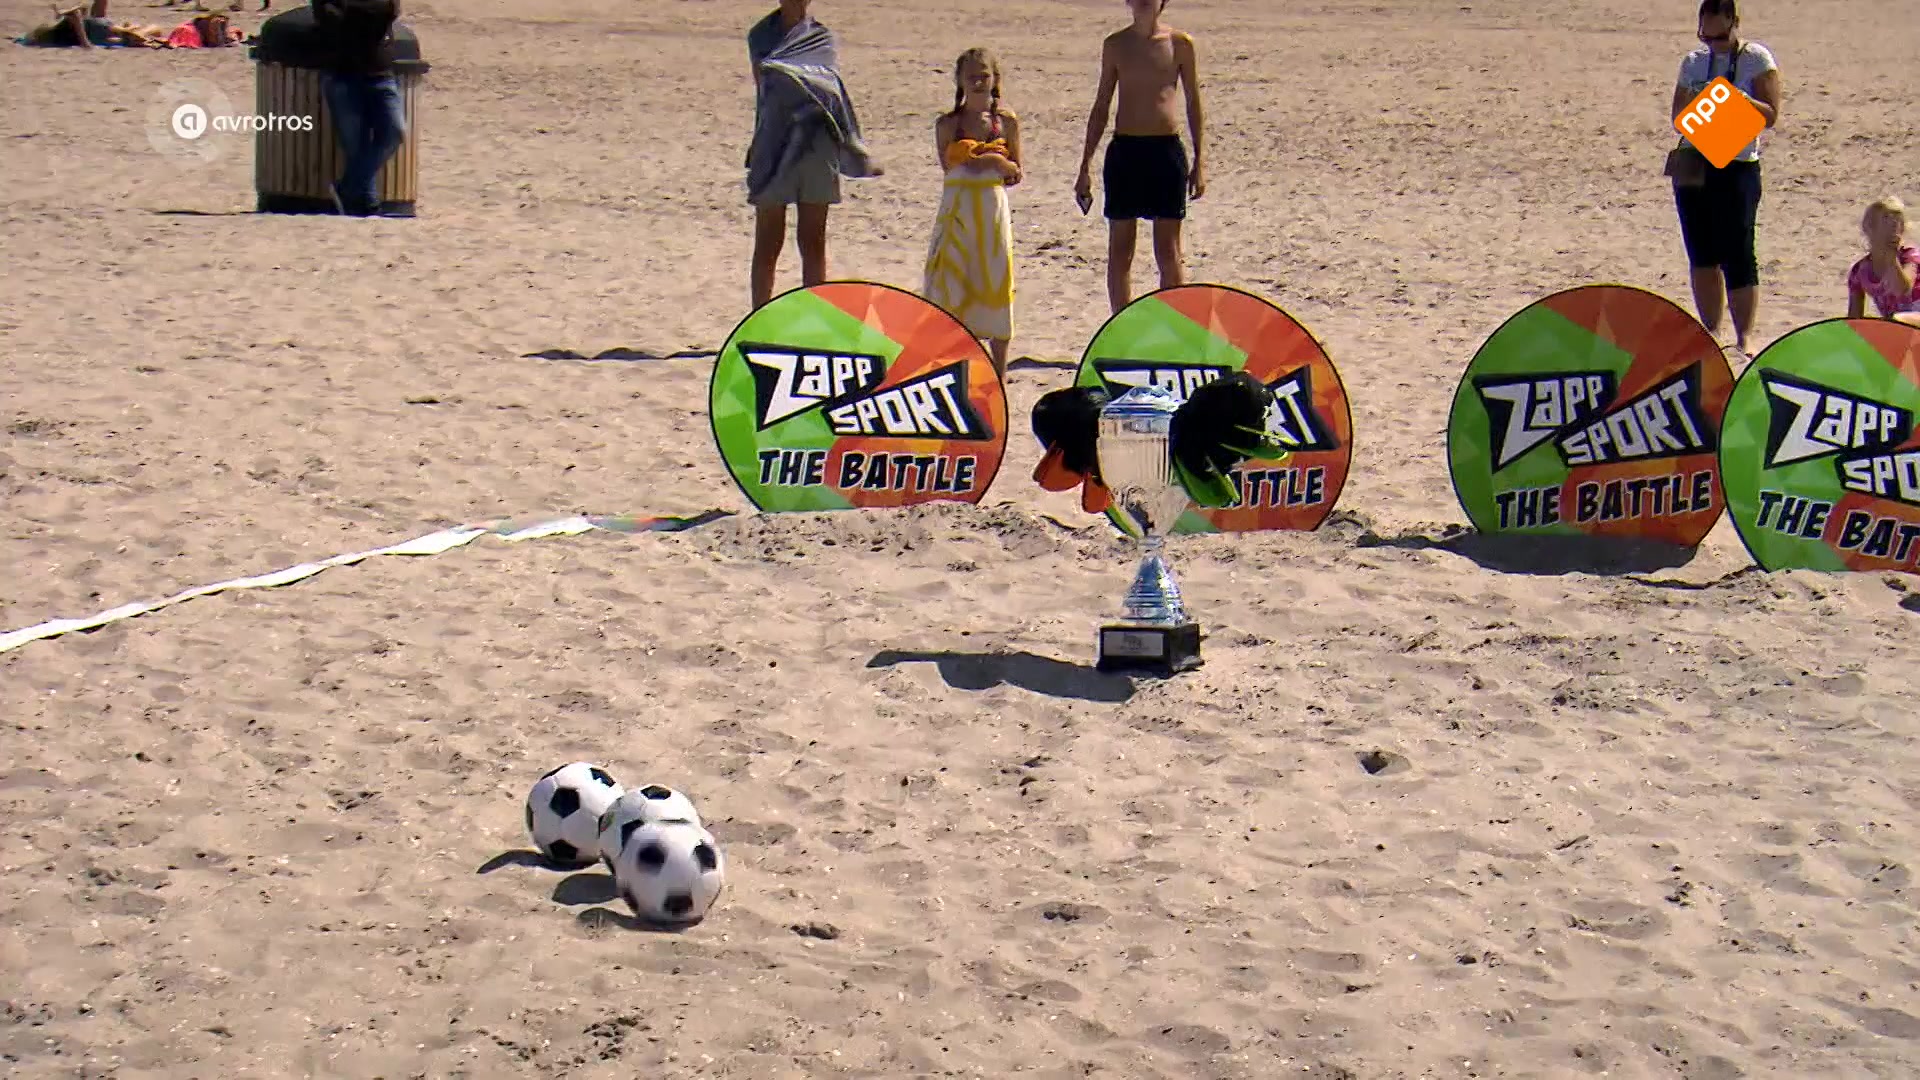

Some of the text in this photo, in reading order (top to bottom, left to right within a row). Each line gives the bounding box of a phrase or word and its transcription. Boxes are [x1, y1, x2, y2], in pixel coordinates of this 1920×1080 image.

[829, 373, 969, 434] SPORT
[1561, 379, 1703, 465] SPORT
[758, 448, 977, 493] THE BATTLE
[1200, 465, 1326, 510] TTLE
[1495, 470, 1713, 528] THE BATTLE
[1755, 489, 1920, 568] THE BAT
